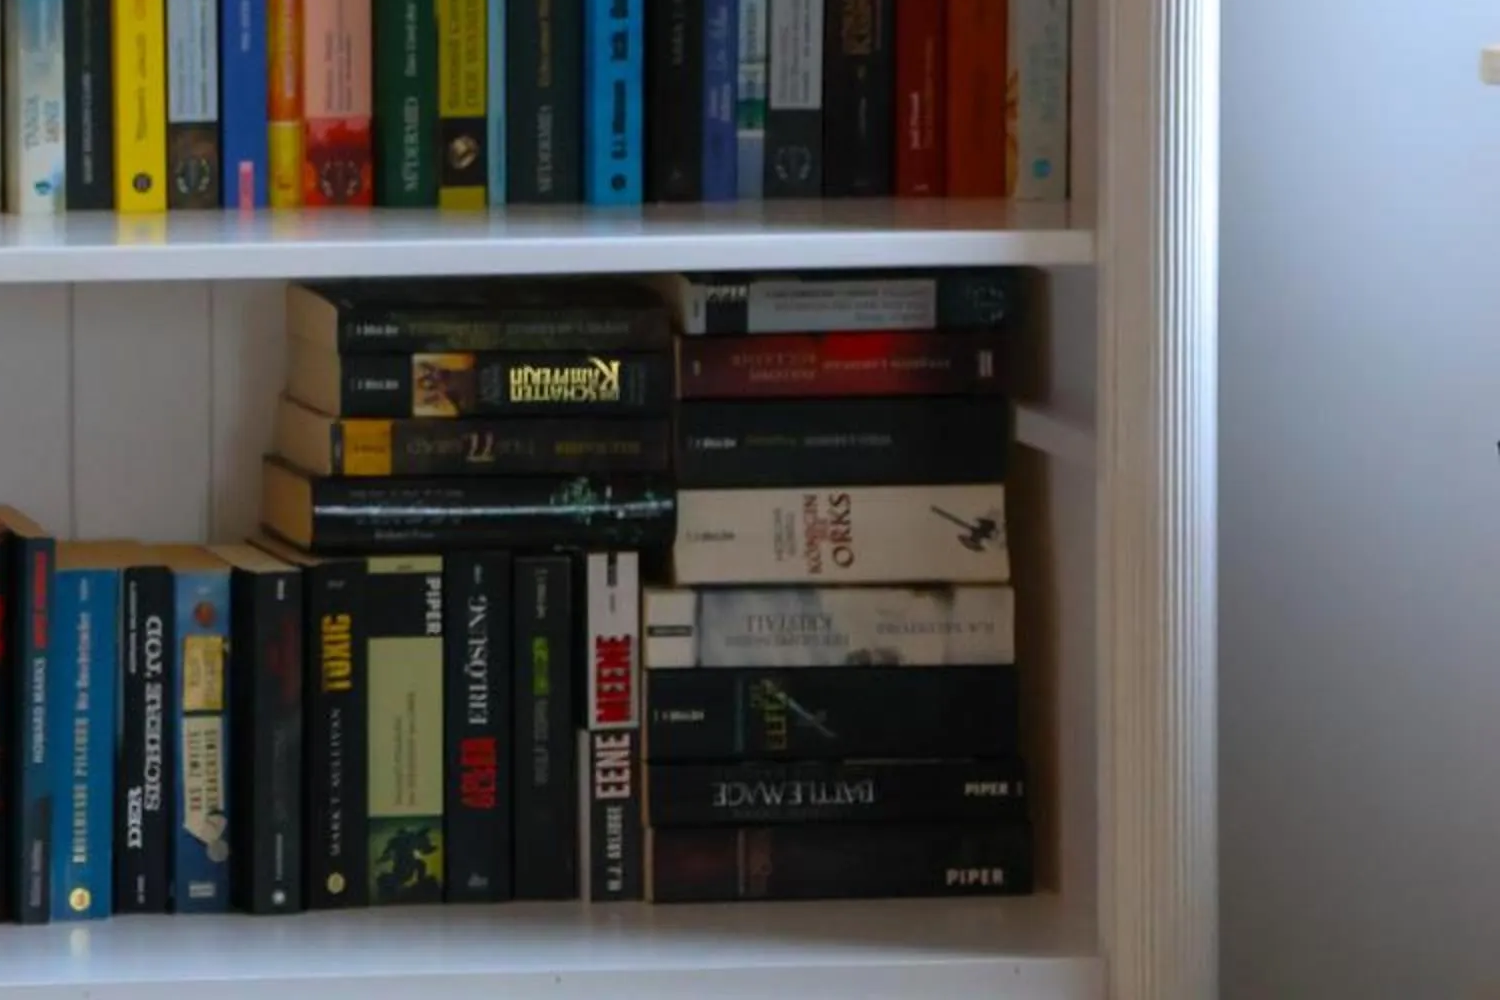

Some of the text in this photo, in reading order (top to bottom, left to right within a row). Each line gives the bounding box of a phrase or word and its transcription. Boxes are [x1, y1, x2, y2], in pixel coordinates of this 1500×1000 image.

[827, 493, 855, 568] ORKS
[425, 575, 443, 635] PIPER
[321, 614, 353, 693] TOXIC
[466, 594, 489, 726] ERLÖSUNG
[596, 633, 631, 723] MEENE
[143, 614, 163, 812] SICHERE TOD
[594, 732, 631, 801] EENE
[711, 779, 874, 806] BATTLEMAGE
[126, 786, 143, 849] DER
[946, 867, 1004, 886] PIPER
